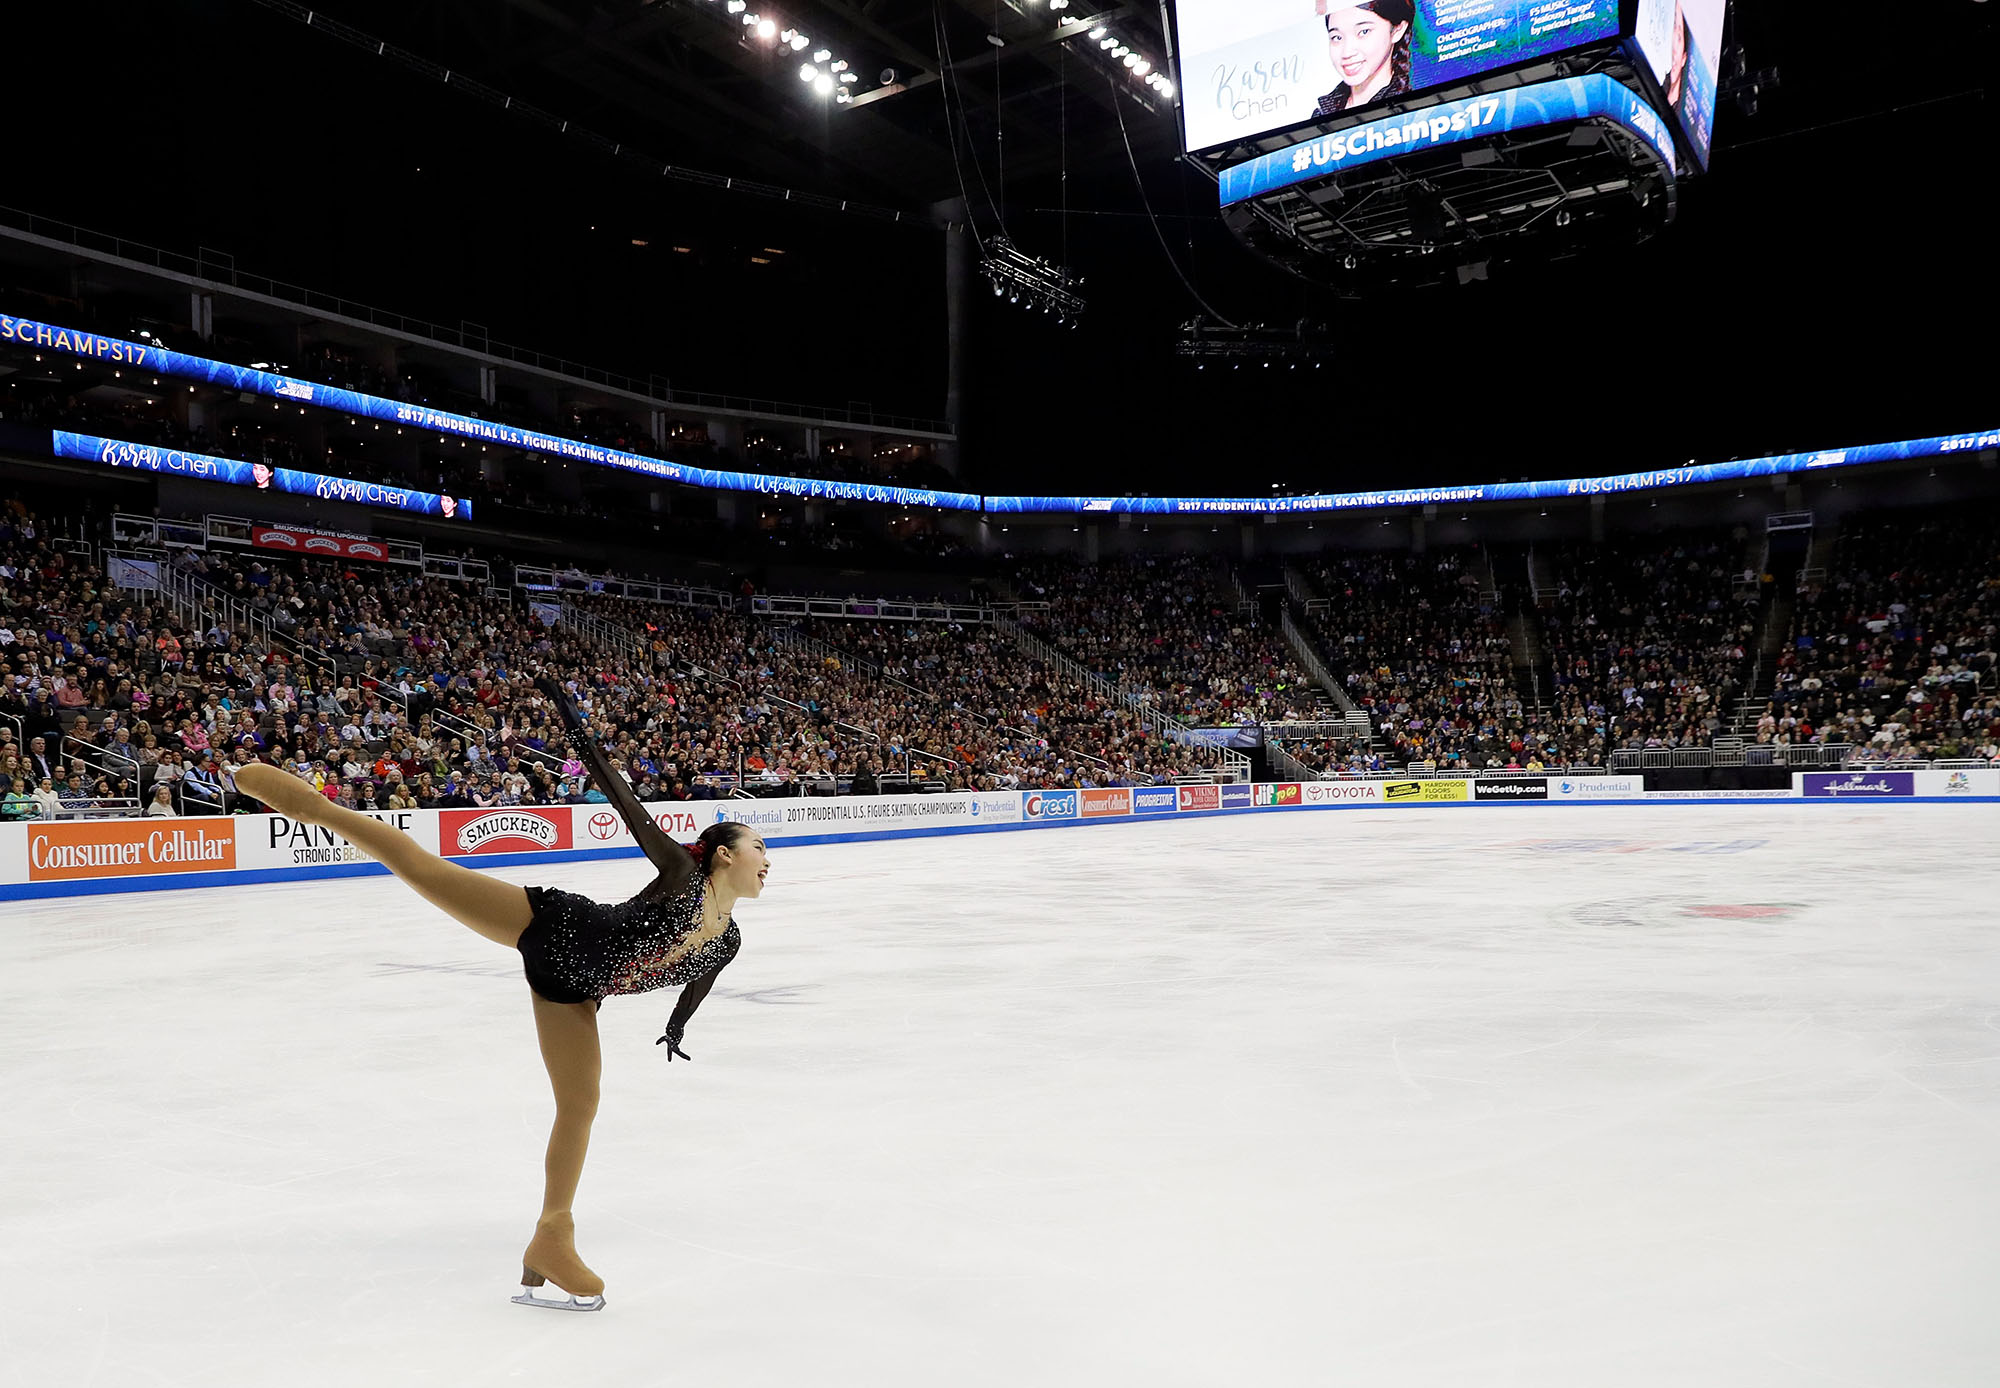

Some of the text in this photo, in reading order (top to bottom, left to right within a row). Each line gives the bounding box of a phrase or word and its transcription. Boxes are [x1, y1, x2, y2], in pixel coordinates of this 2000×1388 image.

[1438, 41, 1459, 53] Karen
[1438, 47, 1472, 62] Jonathan
[1212, 54, 1300, 112] Karen
[1232, 93, 1288, 120] Chen
[1292, 97, 1501, 172] #USChamps17
[397, 408, 680, 478] 2017 PRUDENTIAL U.S. FIGURE SKATING CHAMPIONSHIPS
[1940, 437, 1975, 451] 2017
[100, 438, 217, 476] Karen Chen
[315, 474, 407, 506] Karen Chen
[1568, 469, 1694, 494] #USCHAMPS17
[754, 475, 809, 496] Welcome
[811, 480, 823, 494] to
[825, 483, 864, 499] Kansas
[893, 486, 938, 507] Missouri
[1178, 488, 1484, 511] 2017 PRUDENTIAL U.S. FIGURE SKATING CHAMPIONSHIPS
[316, 529, 336, 538] SUITE
[1194, 787, 1216, 797] VIKING
[1324, 787, 1375, 798] TOYOTA
[1476, 785, 1546, 797] WeGetUp.com
[1578, 782, 1631, 791] Prudential
[1822, 780, 1893, 796] Hallmark
[983, 799, 1016, 813] Prudential
[1027, 794, 1075, 816] Crest
[1135, 793, 1174, 808] PROGRESSIVE
[733, 809, 782, 825] Prudential
[787, 801, 966, 822] 2017 PRUDENTIAL U.S. FIGURE SKATING CHAMPIONSHIPS
[466, 817, 550, 843] SMUCKER'S
[31, 835, 145, 870] Consumer
[293, 849, 330, 863] STRONG
[333, 848, 342, 862] IS
